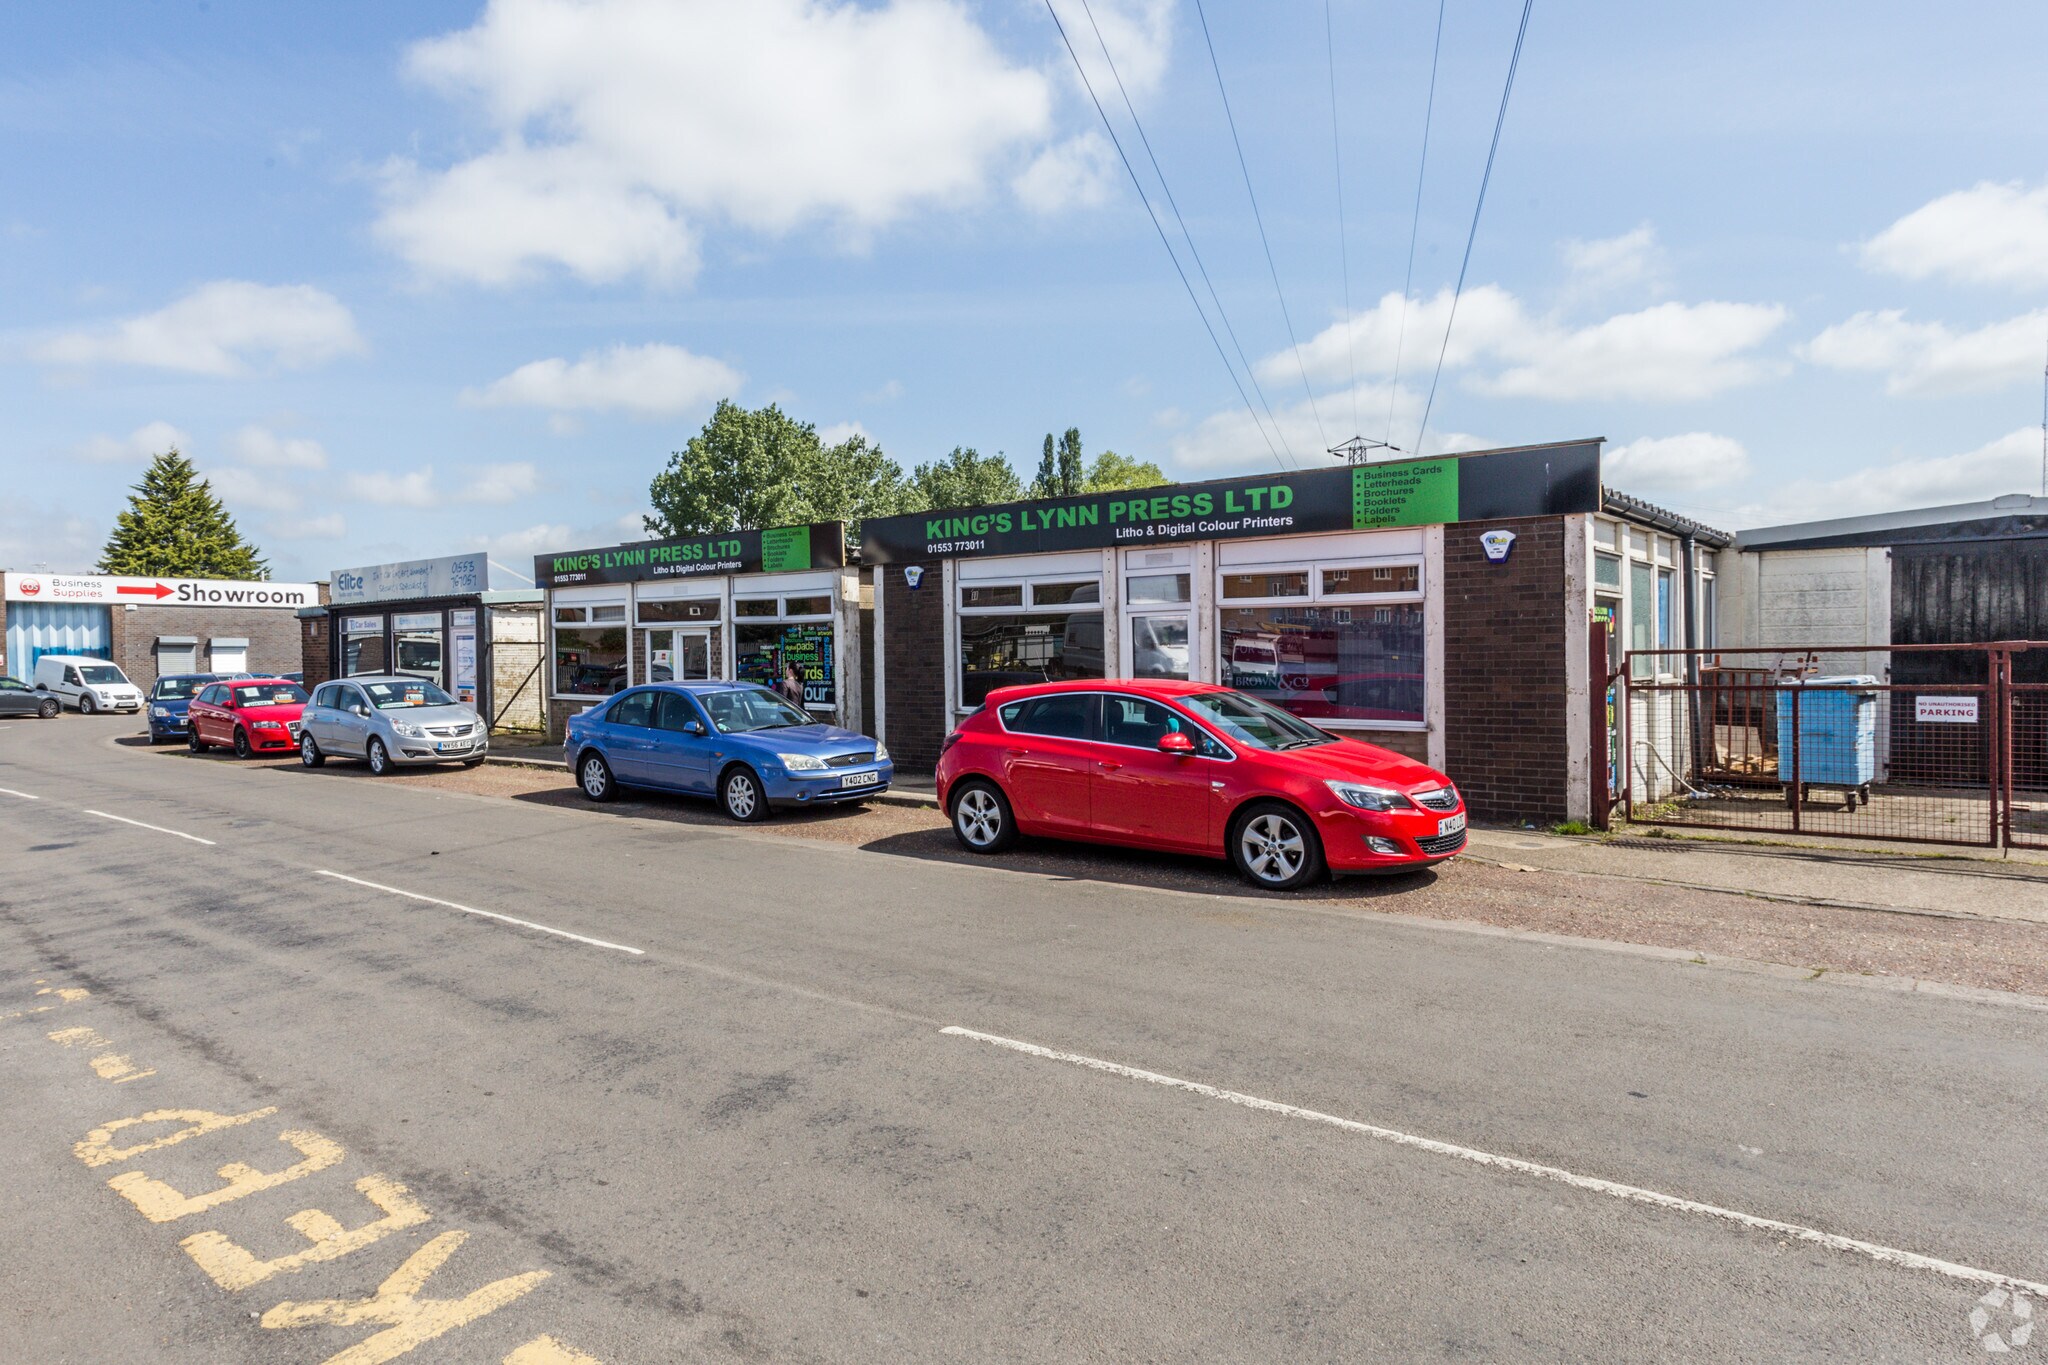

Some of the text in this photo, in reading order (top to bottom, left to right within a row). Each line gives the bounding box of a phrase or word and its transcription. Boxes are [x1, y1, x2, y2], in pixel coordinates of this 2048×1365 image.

[1364, 466, 1442, 480] Business Cards
[1364, 477, 1421, 489] Letterheads
[1364, 487, 1414, 498] Brochures
[1364, 496, 1406, 506] Booklets
[926, 485, 1293, 540] KING'S LYNN PRESS LTD
[1364, 506, 1400, 515] Folders
[1364, 514, 1396, 524] Labels
[1116, 516, 1293, 538] Litho & Digital Colour Printers
[928, 540, 984, 554] 01553 773011
[554, 540, 741, 572] KING'S LYNN PRESS LTD
[653, 566, 668, 574] Litho
[676, 564, 694, 574] Digital
[696, 562, 716, 571] Colour
[718, 561, 742, 569] Printers
[52, 579, 102, 588] Business
[338, 574, 364, 590] Elite
[53, 589, 103, 598] Supplies
[178, 584, 304, 604] Showroom
[796, 641, 814, 653] pads
[786, 652, 818, 661] business
[805, 666, 823, 680] rds
[804, 687, 828, 701] our
[845, 776, 861, 786] Y402
